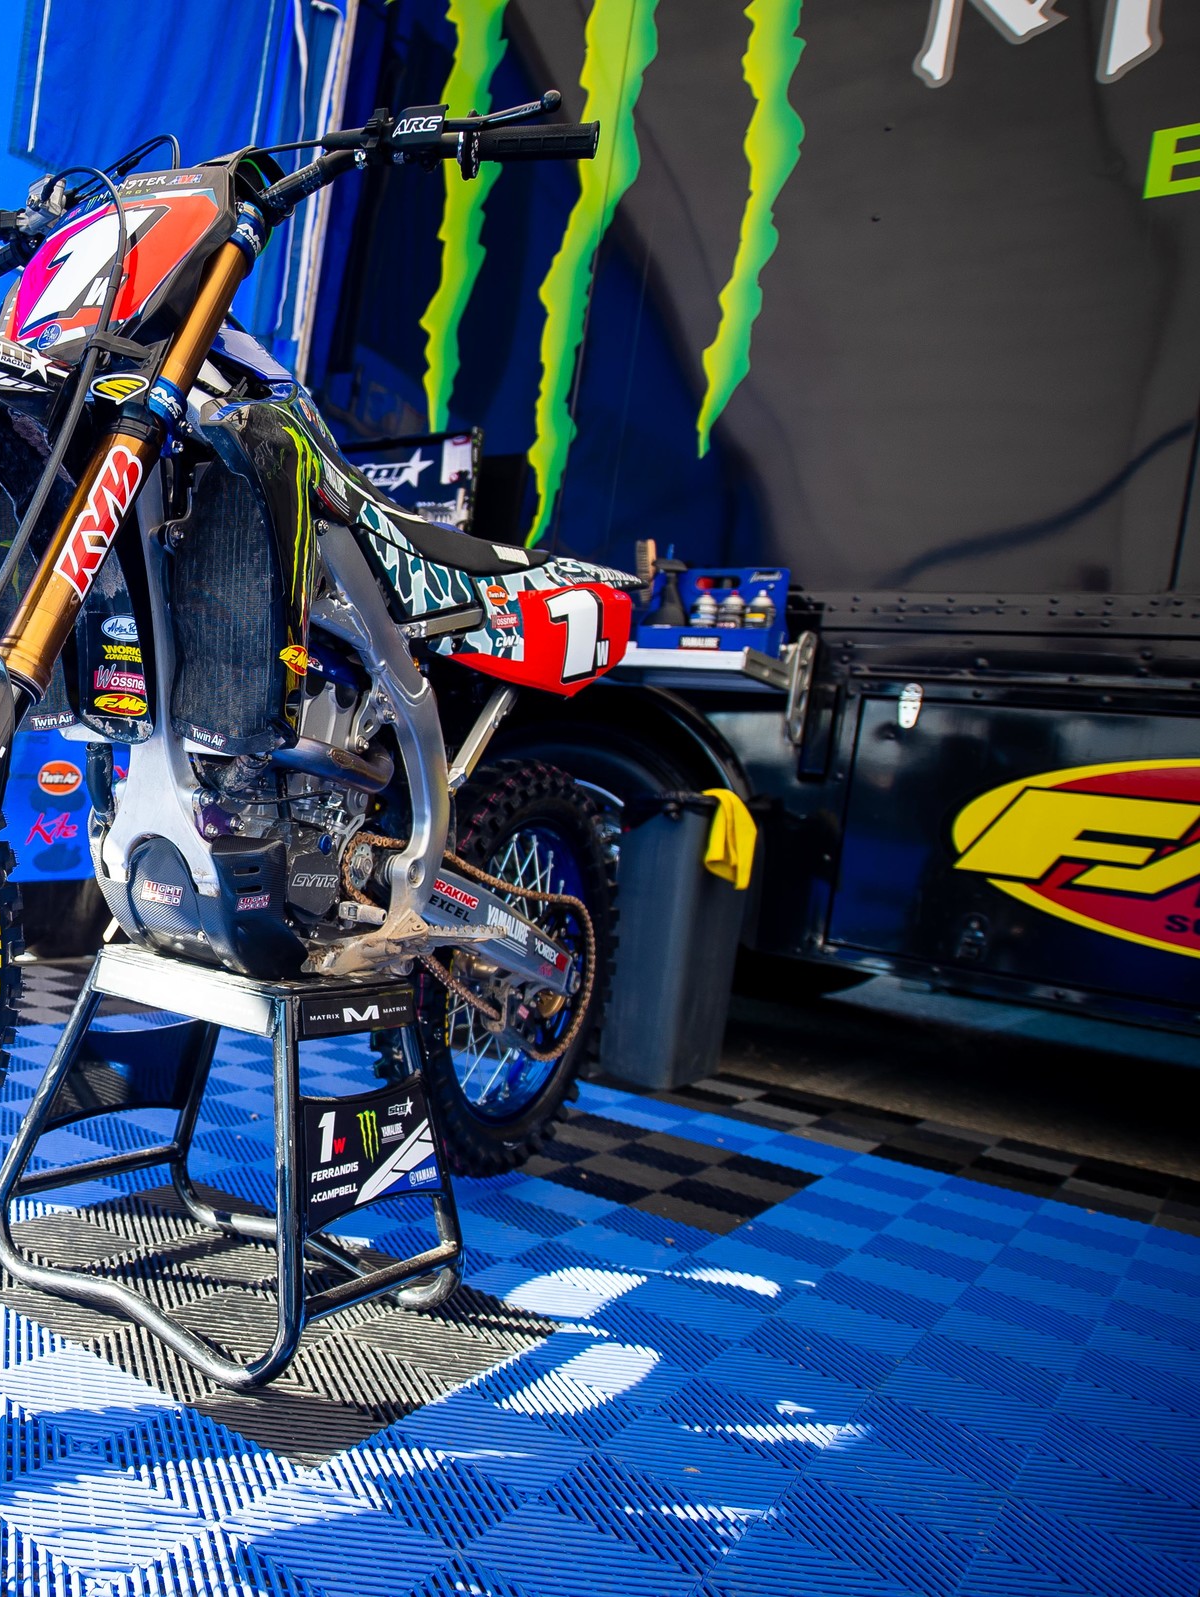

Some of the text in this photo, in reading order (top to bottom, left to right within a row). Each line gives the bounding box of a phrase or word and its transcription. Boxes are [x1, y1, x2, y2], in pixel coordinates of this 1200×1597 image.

[392, 115, 443, 138] ARC
[0, 355, 32, 370] RACING
[53, 445, 143, 602] KYB
[546, 588, 601, 681] 1
[596, 640, 609, 667] W
[95, 696, 148, 712] FMF
[31, 712, 74, 728] Twin Air
[191, 726, 212, 743] Twin
[212, 734, 226, 747] Air
[291, 873, 339, 888] GYTR
[237, 902, 269, 911] SPEED
[239, 894, 270, 905] LIGHT
[429, 894, 470, 923] EXCEL
[486, 904, 531, 946] YAMALUBE
[309, 1012, 340, 1021] MATRIX
[383, 1005, 407, 1014] MATRIX
[317, 1111, 336, 1163] 1
[311, 1161, 359, 1183] FERRANDIS
[414, 1166, 437, 1182] YAMAHA
